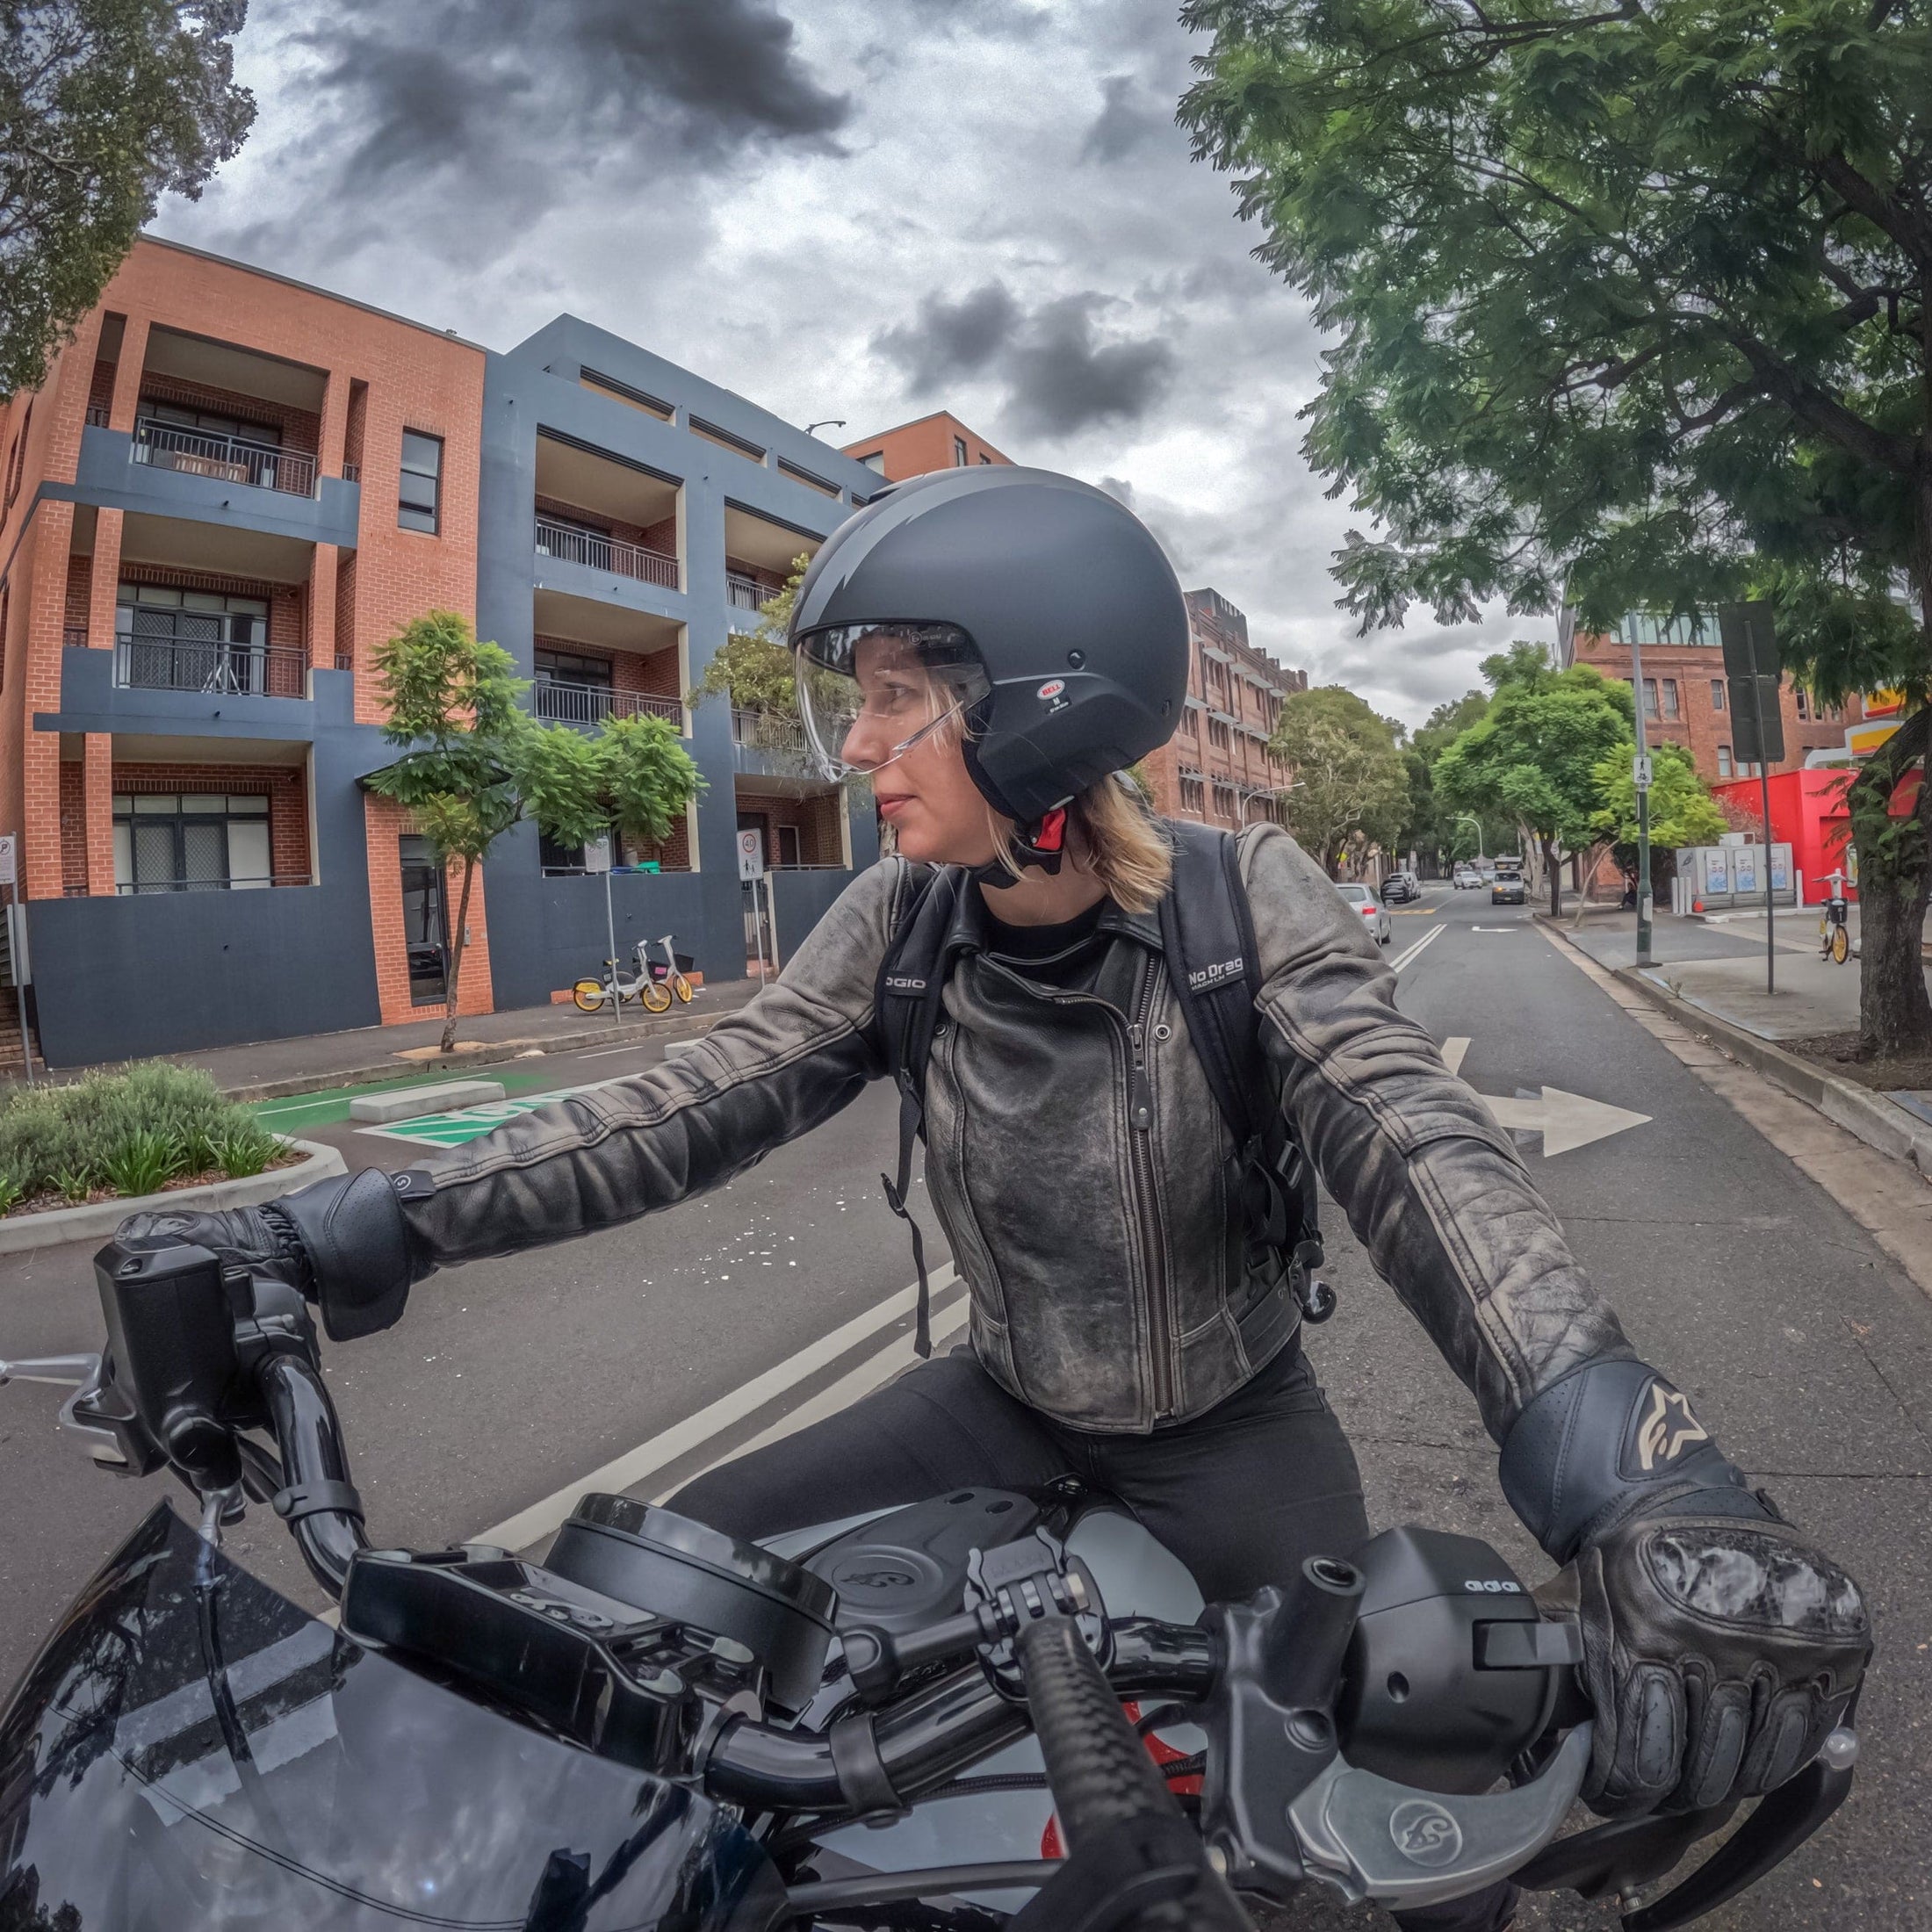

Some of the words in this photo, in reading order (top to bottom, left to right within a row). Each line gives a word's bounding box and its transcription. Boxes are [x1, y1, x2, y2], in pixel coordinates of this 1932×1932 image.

[1042, 684, 1061, 696] BELL
[1188, 971, 1206, 985] No
[1208, 957, 1244, 977] Drag
